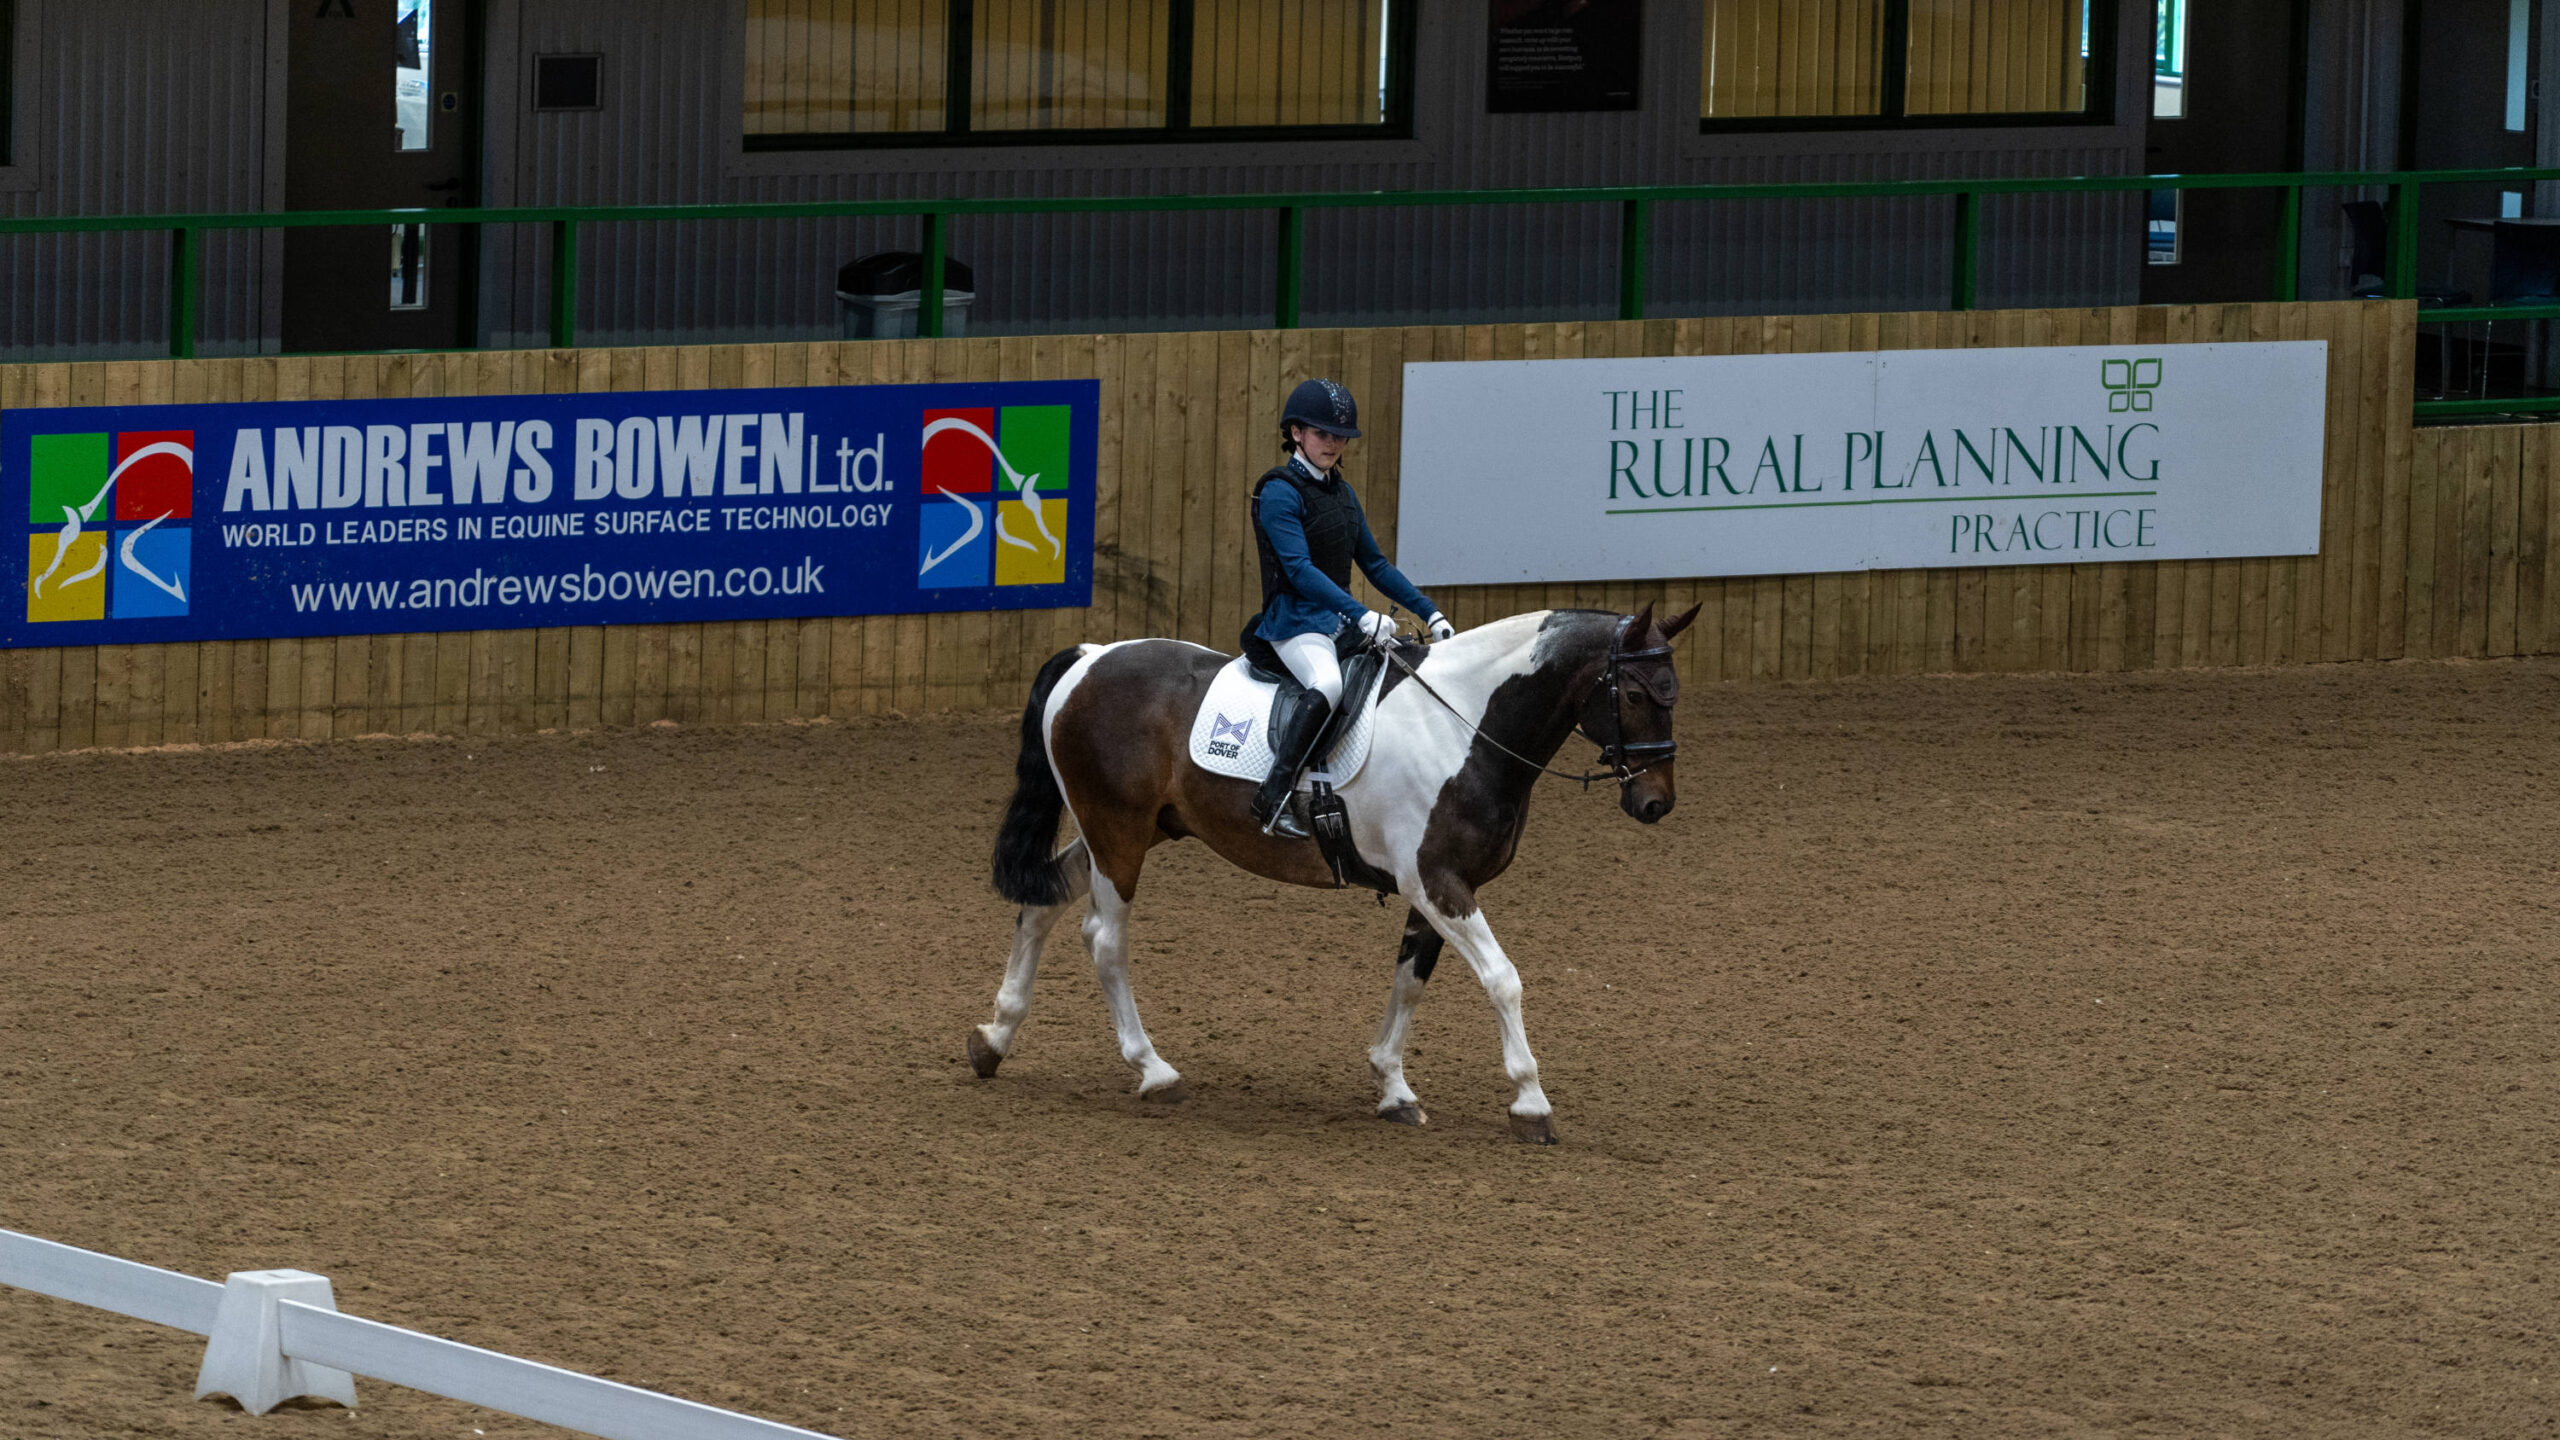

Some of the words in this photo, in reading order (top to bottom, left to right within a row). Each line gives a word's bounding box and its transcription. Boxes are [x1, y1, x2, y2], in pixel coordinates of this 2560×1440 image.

[1602, 389, 1685, 431] THE
[223, 419, 554, 512] ANDREWS
[574, 412, 804, 500] BOWEN
[809, 433, 893, 493] Ltd.
[1607, 434, 1823, 500] RURAL
[1842, 422, 2161, 491] PLANNING
[223, 523, 316, 548] WORLD
[326, 518, 448, 545] LEADERS
[458, 517, 482, 540] IN
[491, 513, 585, 539] EQUINE
[594, 509, 711, 535] SURFACE
[721, 503, 892, 530] TECHNOLOGY
[1949, 508, 2157, 554] PRACTICE
[291, 556, 824, 612] www.andrewsbowen.co.uk
[1208, 747, 1238, 759] DOVER
[1210, 740, 1230, 750] PORT
